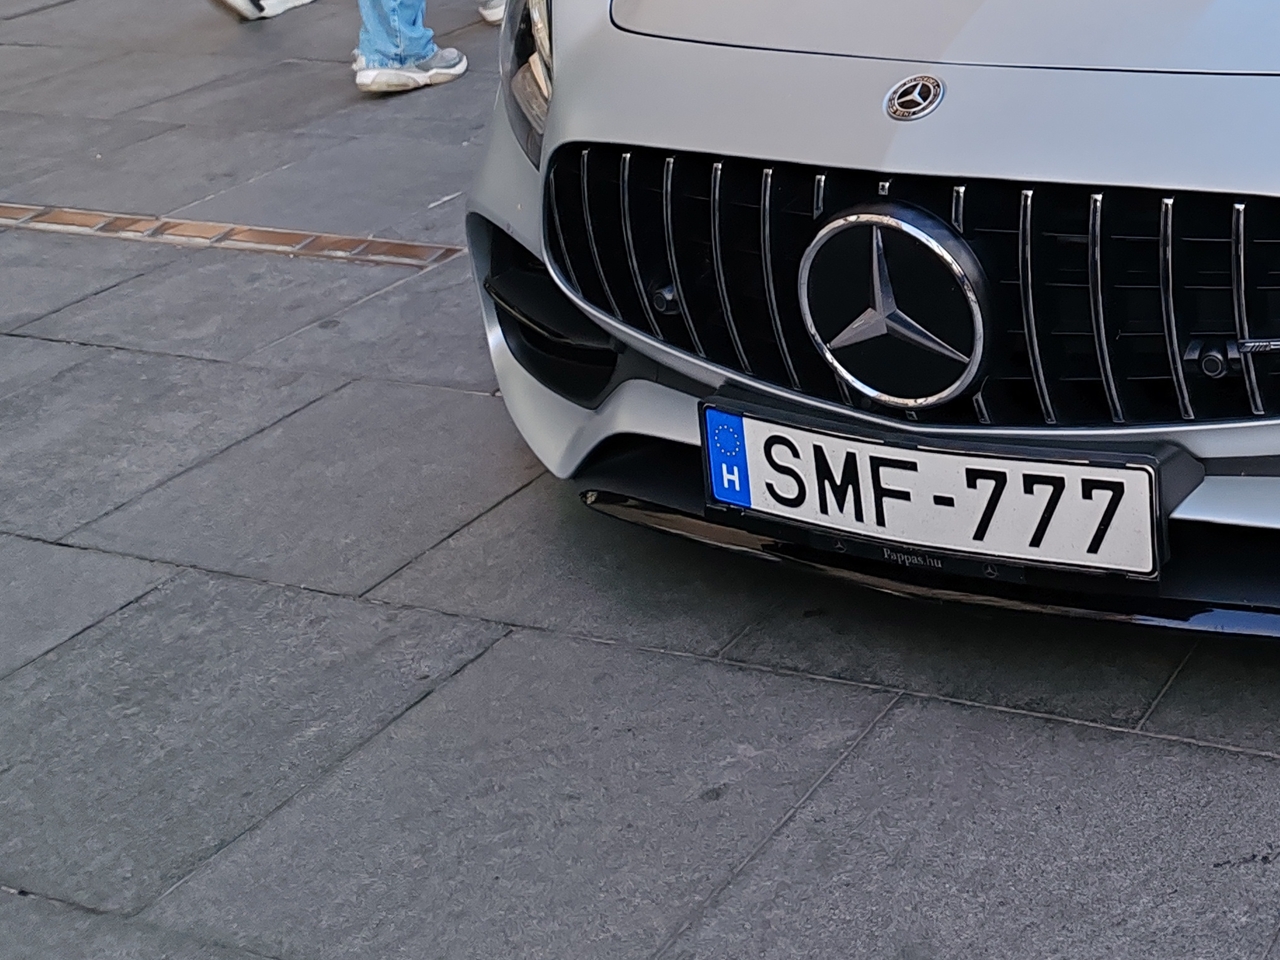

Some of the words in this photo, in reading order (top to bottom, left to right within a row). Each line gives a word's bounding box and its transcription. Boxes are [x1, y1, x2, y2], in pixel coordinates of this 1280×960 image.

[721, 462, 740, 492] H
[763, 433, 1126, 555] SMF-777
[882, 547, 943, 568] Pappas.hu
